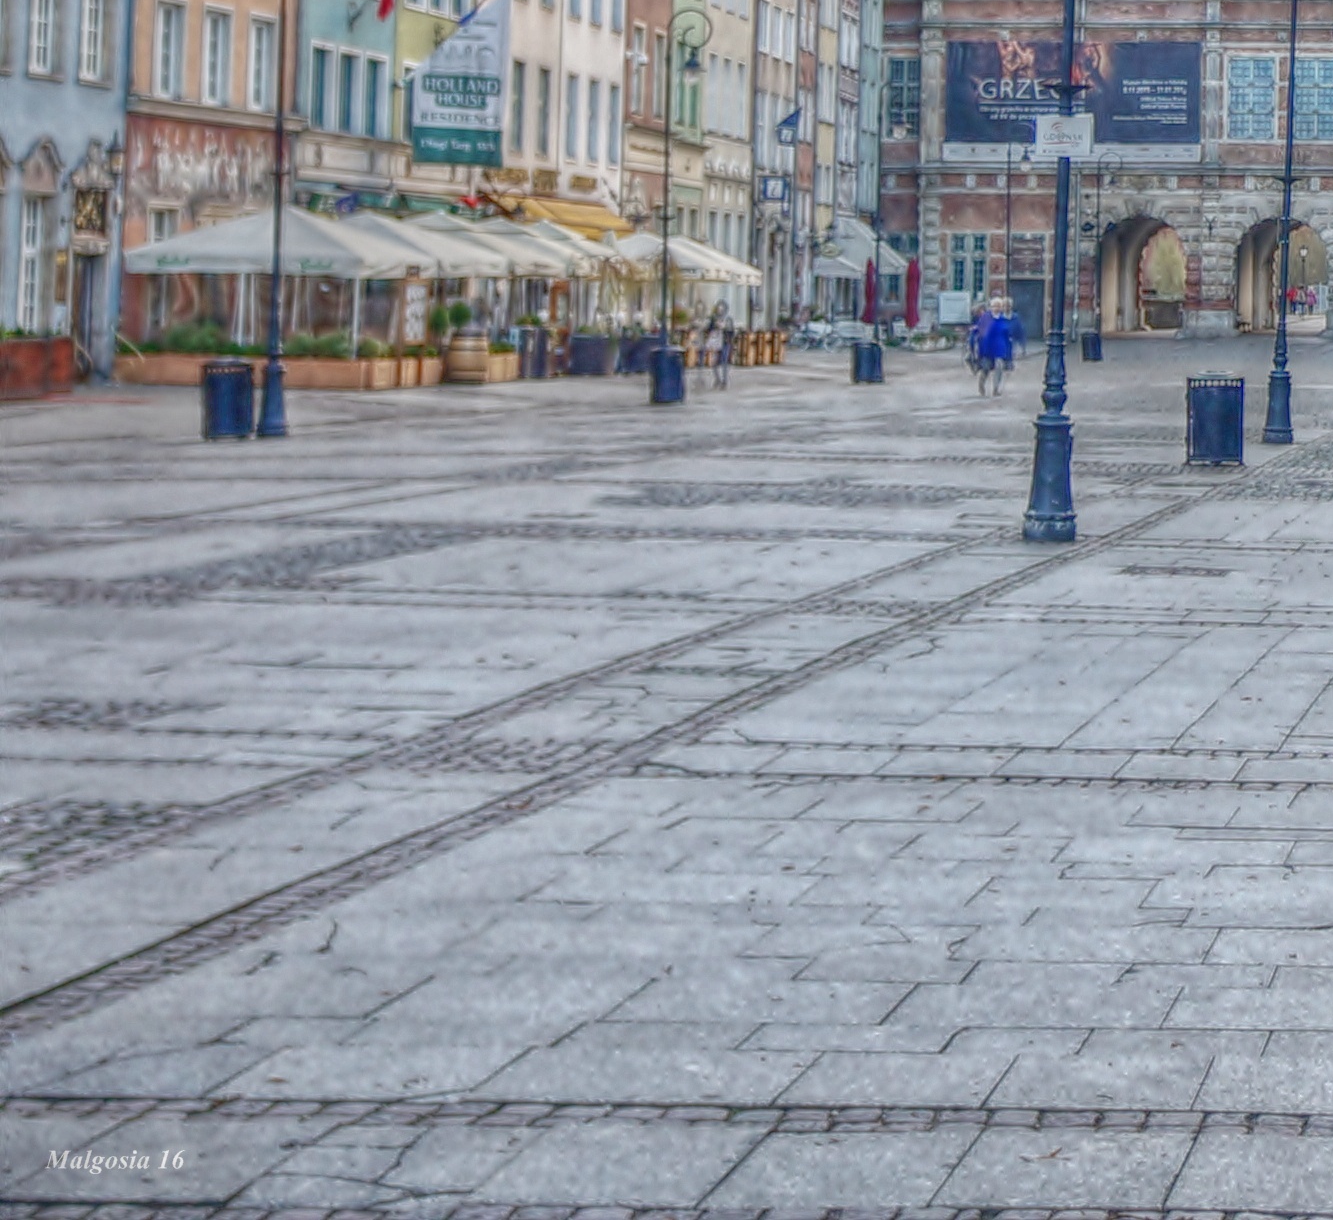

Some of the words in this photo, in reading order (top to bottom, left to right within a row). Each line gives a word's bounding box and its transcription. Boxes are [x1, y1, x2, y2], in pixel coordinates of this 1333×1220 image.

[424, 78, 499, 94] HOLLAND
[437, 93, 487, 107] HOUSE
[421, 112, 500, 126] RESIDENCE
